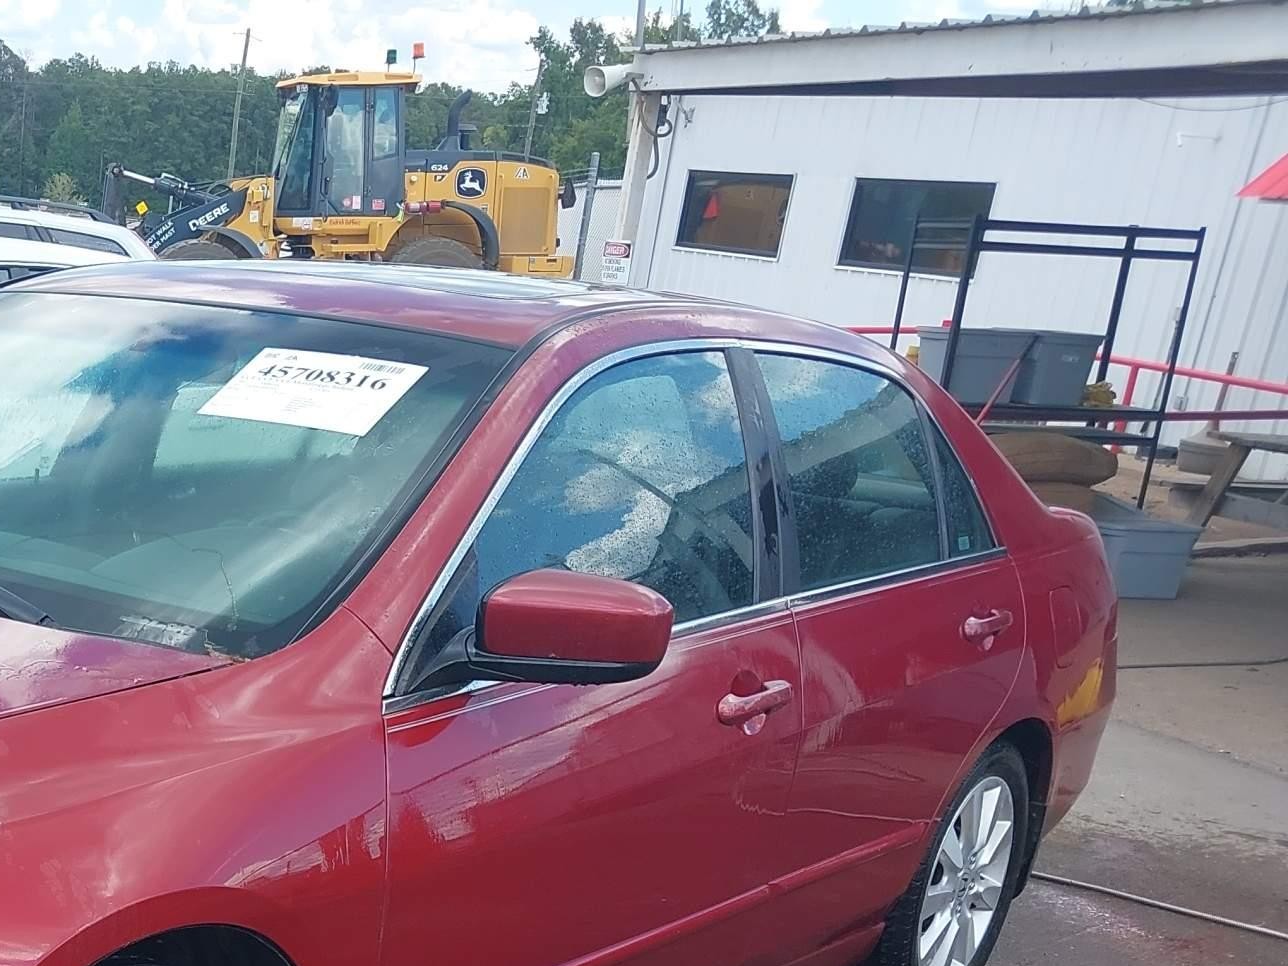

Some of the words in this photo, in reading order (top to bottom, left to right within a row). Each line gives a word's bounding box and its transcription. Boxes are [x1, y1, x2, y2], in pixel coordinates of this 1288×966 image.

[188, 202, 230, 231] DEERE
[156, 220, 174, 237] WALK
[161, 228, 176, 243] MAST
[258, 364, 388, 391] 45708316
